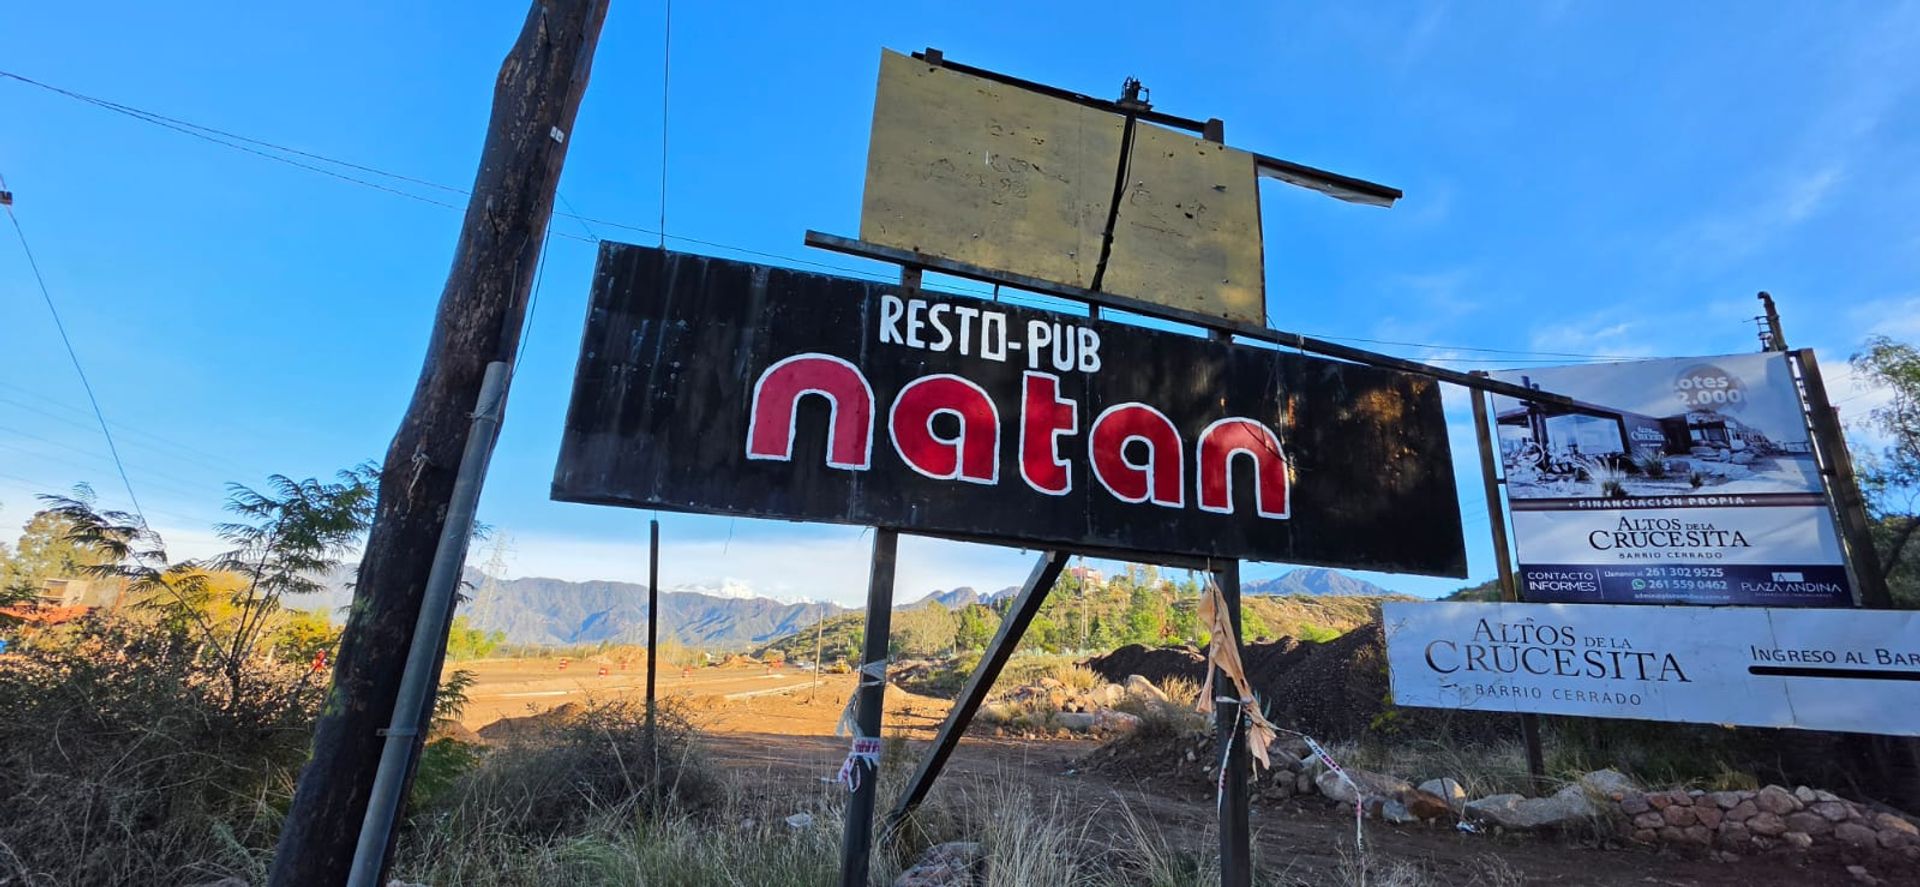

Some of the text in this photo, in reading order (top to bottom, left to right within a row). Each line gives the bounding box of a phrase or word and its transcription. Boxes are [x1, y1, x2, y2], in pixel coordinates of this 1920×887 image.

[880, 295, 1101, 373] RESTO-PUB
[1674, 376, 1729, 390] otes
[746, 353, 1291, 519] natan
[1579, 496, 1745, 508] FINANCIACIÓN PROPIA
[1617, 516, 1715, 531] ALTOS DE LA
[1588, 530, 1751, 551] CRUCESITA
[1619, 552, 1723, 560] BARRIO CERRADO
[1527, 571, 1594, 580] CONTACTO
[1645, 567, 1665, 577] 261
[1669, 567, 1692, 577] 302
[1693, 567, 1724, 578] 9525
[1529, 581, 1596, 592] INFORMES
[1648, 579, 1728, 590] 261 559 0462
[1741, 582, 1842, 593] PLAZA ANDINA
[1473, 617, 1632, 649] ALTOS DE LA
[1424, 639, 1692, 683] CRUCESITA
[1750, 644, 1837, 664] INGRESO
[1845, 651, 1870, 665] AL
[1475, 683, 1642, 706] BARRIO CERRADO
